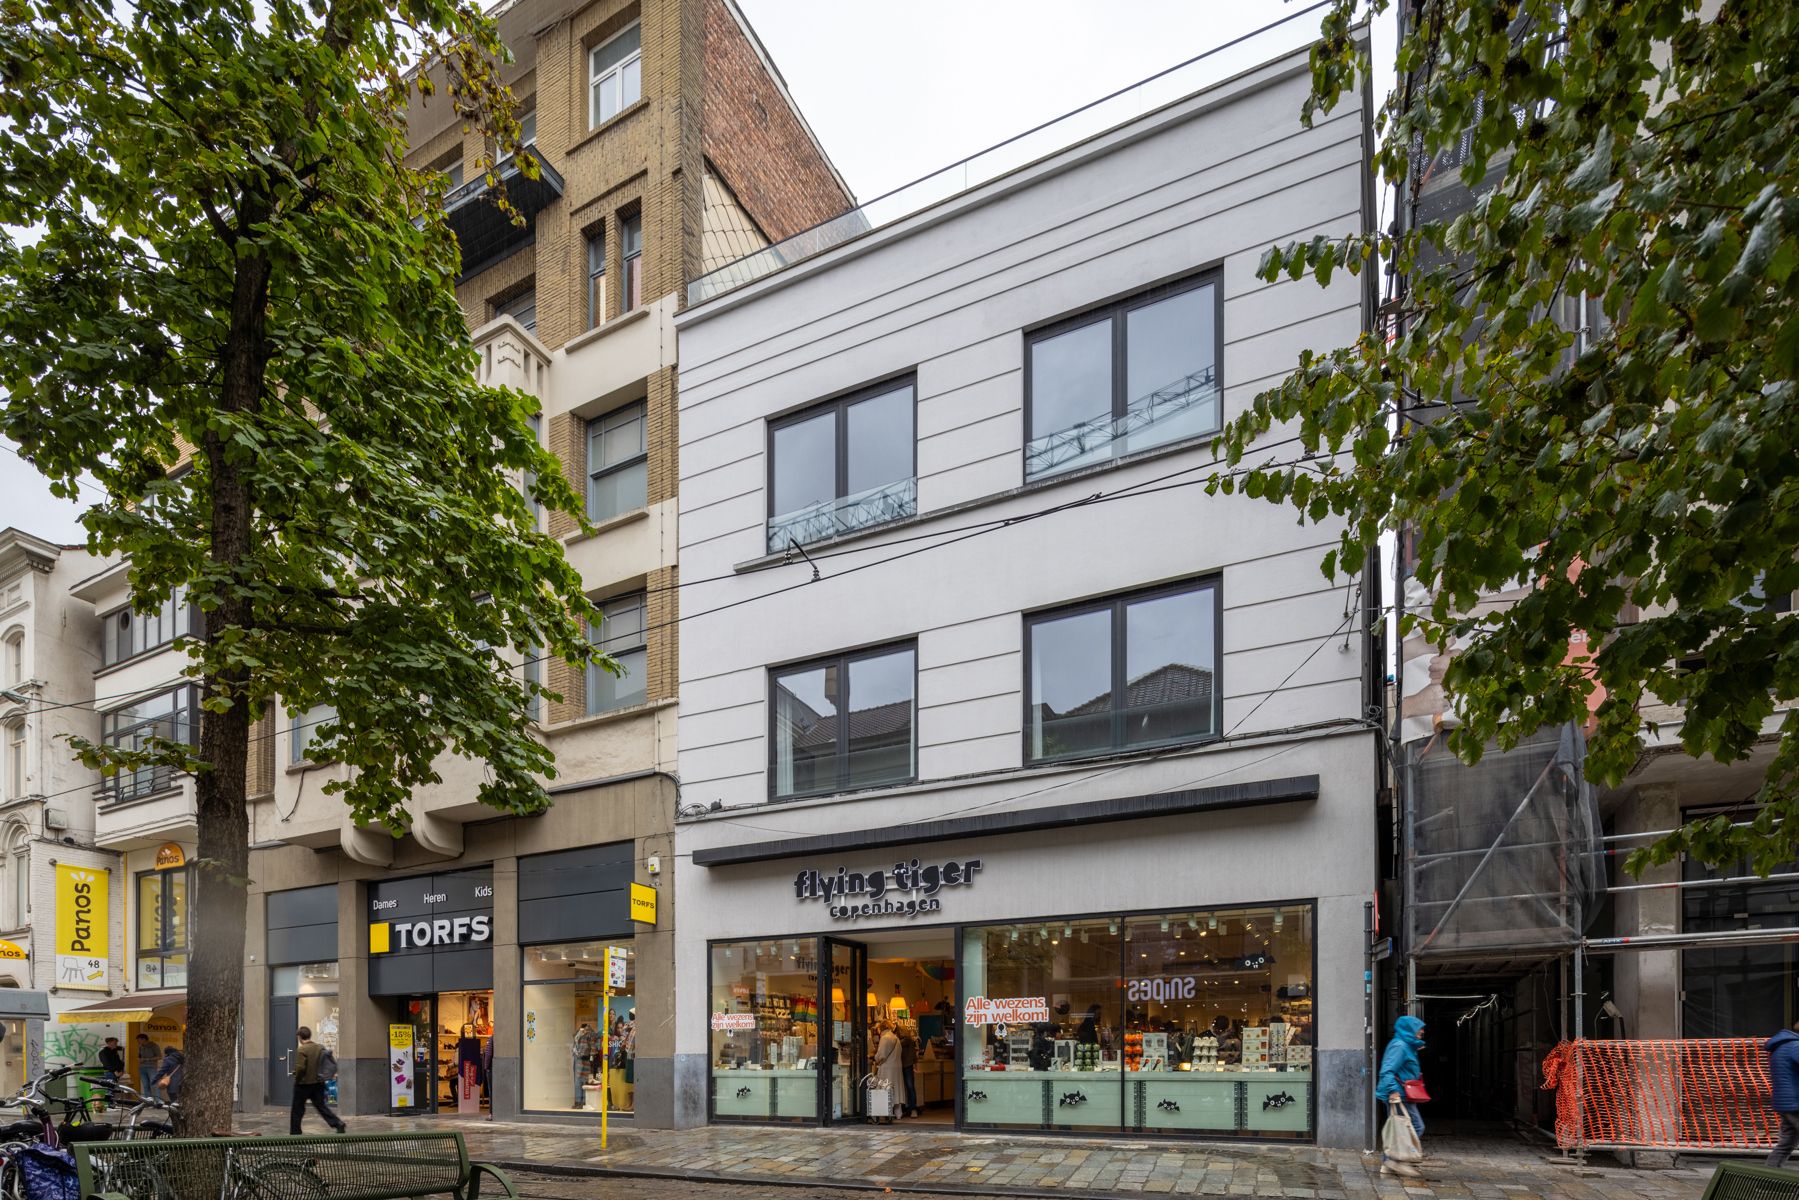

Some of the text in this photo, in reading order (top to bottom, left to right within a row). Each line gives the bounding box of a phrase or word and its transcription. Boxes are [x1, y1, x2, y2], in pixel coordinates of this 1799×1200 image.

[156, 855, 180, 866] Panos
[794, 858, 982, 904] flying tiger
[373, 886, 493, 910] Dames Heren Kids
[632, 898, 655, 909] TORFS
[830, 898, 940, 919] copenhagen
[71, 882, 91, 952] Panos
[395, 916, 490, 948] TORFS
[0, 950, 21, 958] nos
[88, 960, 100, 969] 48
[966, 997, 1045, 1010] Alle wezens
[712, 1012, 753, 1021] Alle wezens
[966, 1009, 1048, 1026] zijn welkom!
[147, 1023, 178, 1031] Panos
[712, 1020, 755, 1031] zijn welkom!
